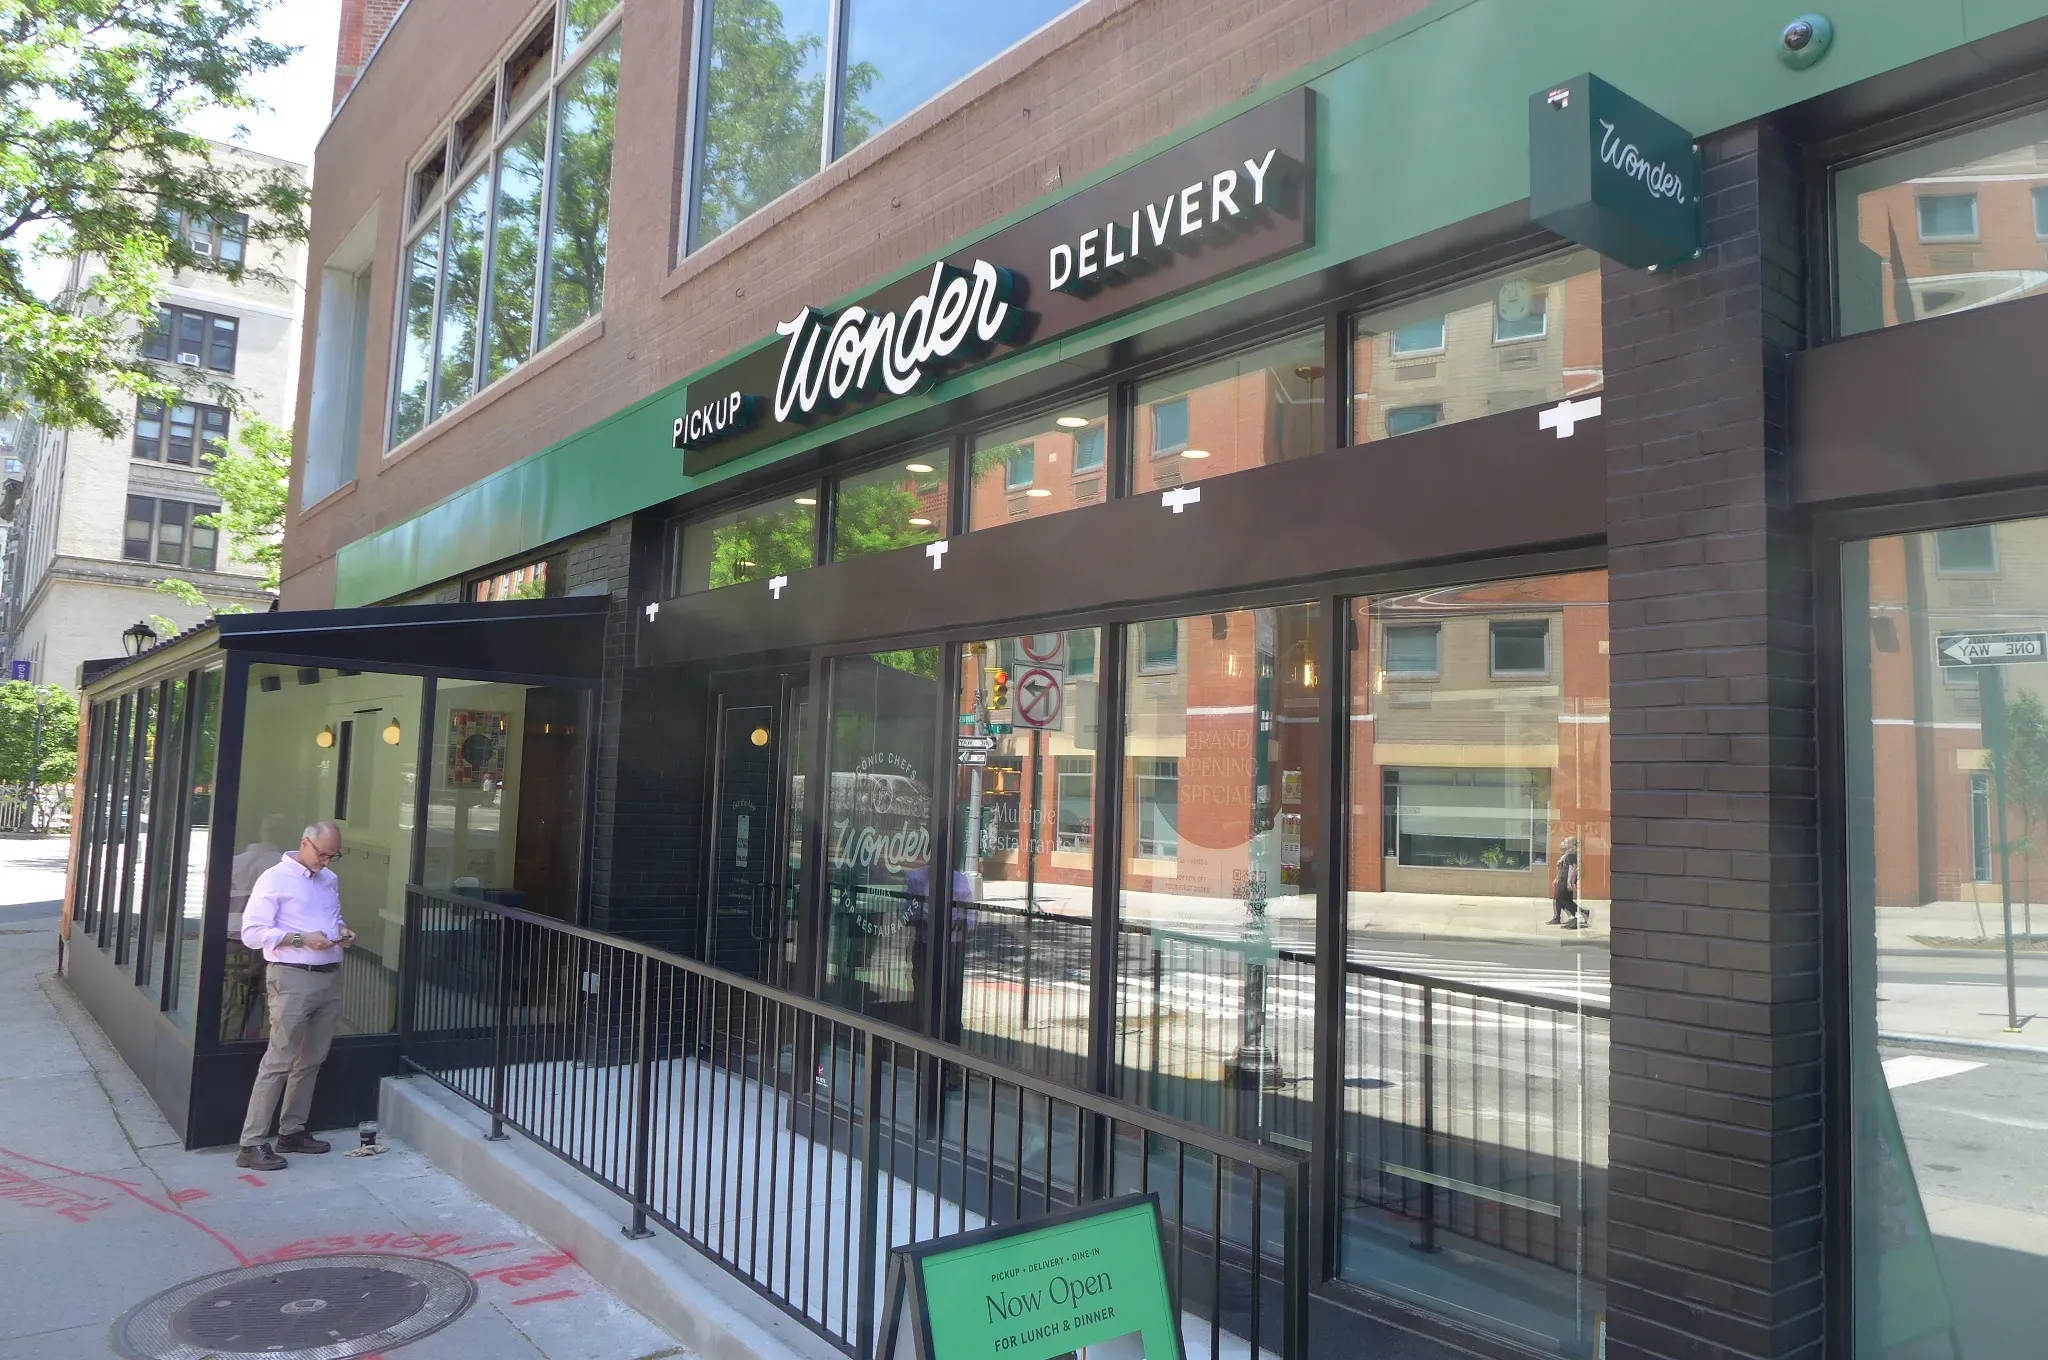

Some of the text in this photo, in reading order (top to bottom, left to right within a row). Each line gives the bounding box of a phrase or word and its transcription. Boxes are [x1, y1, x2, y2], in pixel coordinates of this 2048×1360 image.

[1599, 118, 1685, 204] Wonder
[1050, 149, 1277, 291] DELIVERY
[775, 259, 1008, 423] Wonder
[672, 391, 741, 449] PICKUP
[1187, 729, 1250, 750] GRAND
[888, 752, 917, 780] CHEFS
[1177, 757, 1260, 778] OPENING
[995, 802, 1056, 829] Multiple
[1180, 784, 1256, 807] SPECIAL
[833, 819, 931, 874] Wonder
[841, 888, 919, 937] TOP RESTAURANTS
[991, 1247, 1100, 1282] PICKUP DELIVERY DINE-IN
[986, 1272, 1113, 1325] Now Open
[994, 1306, 1115, 1353] FOR LUNCH & DINNER
